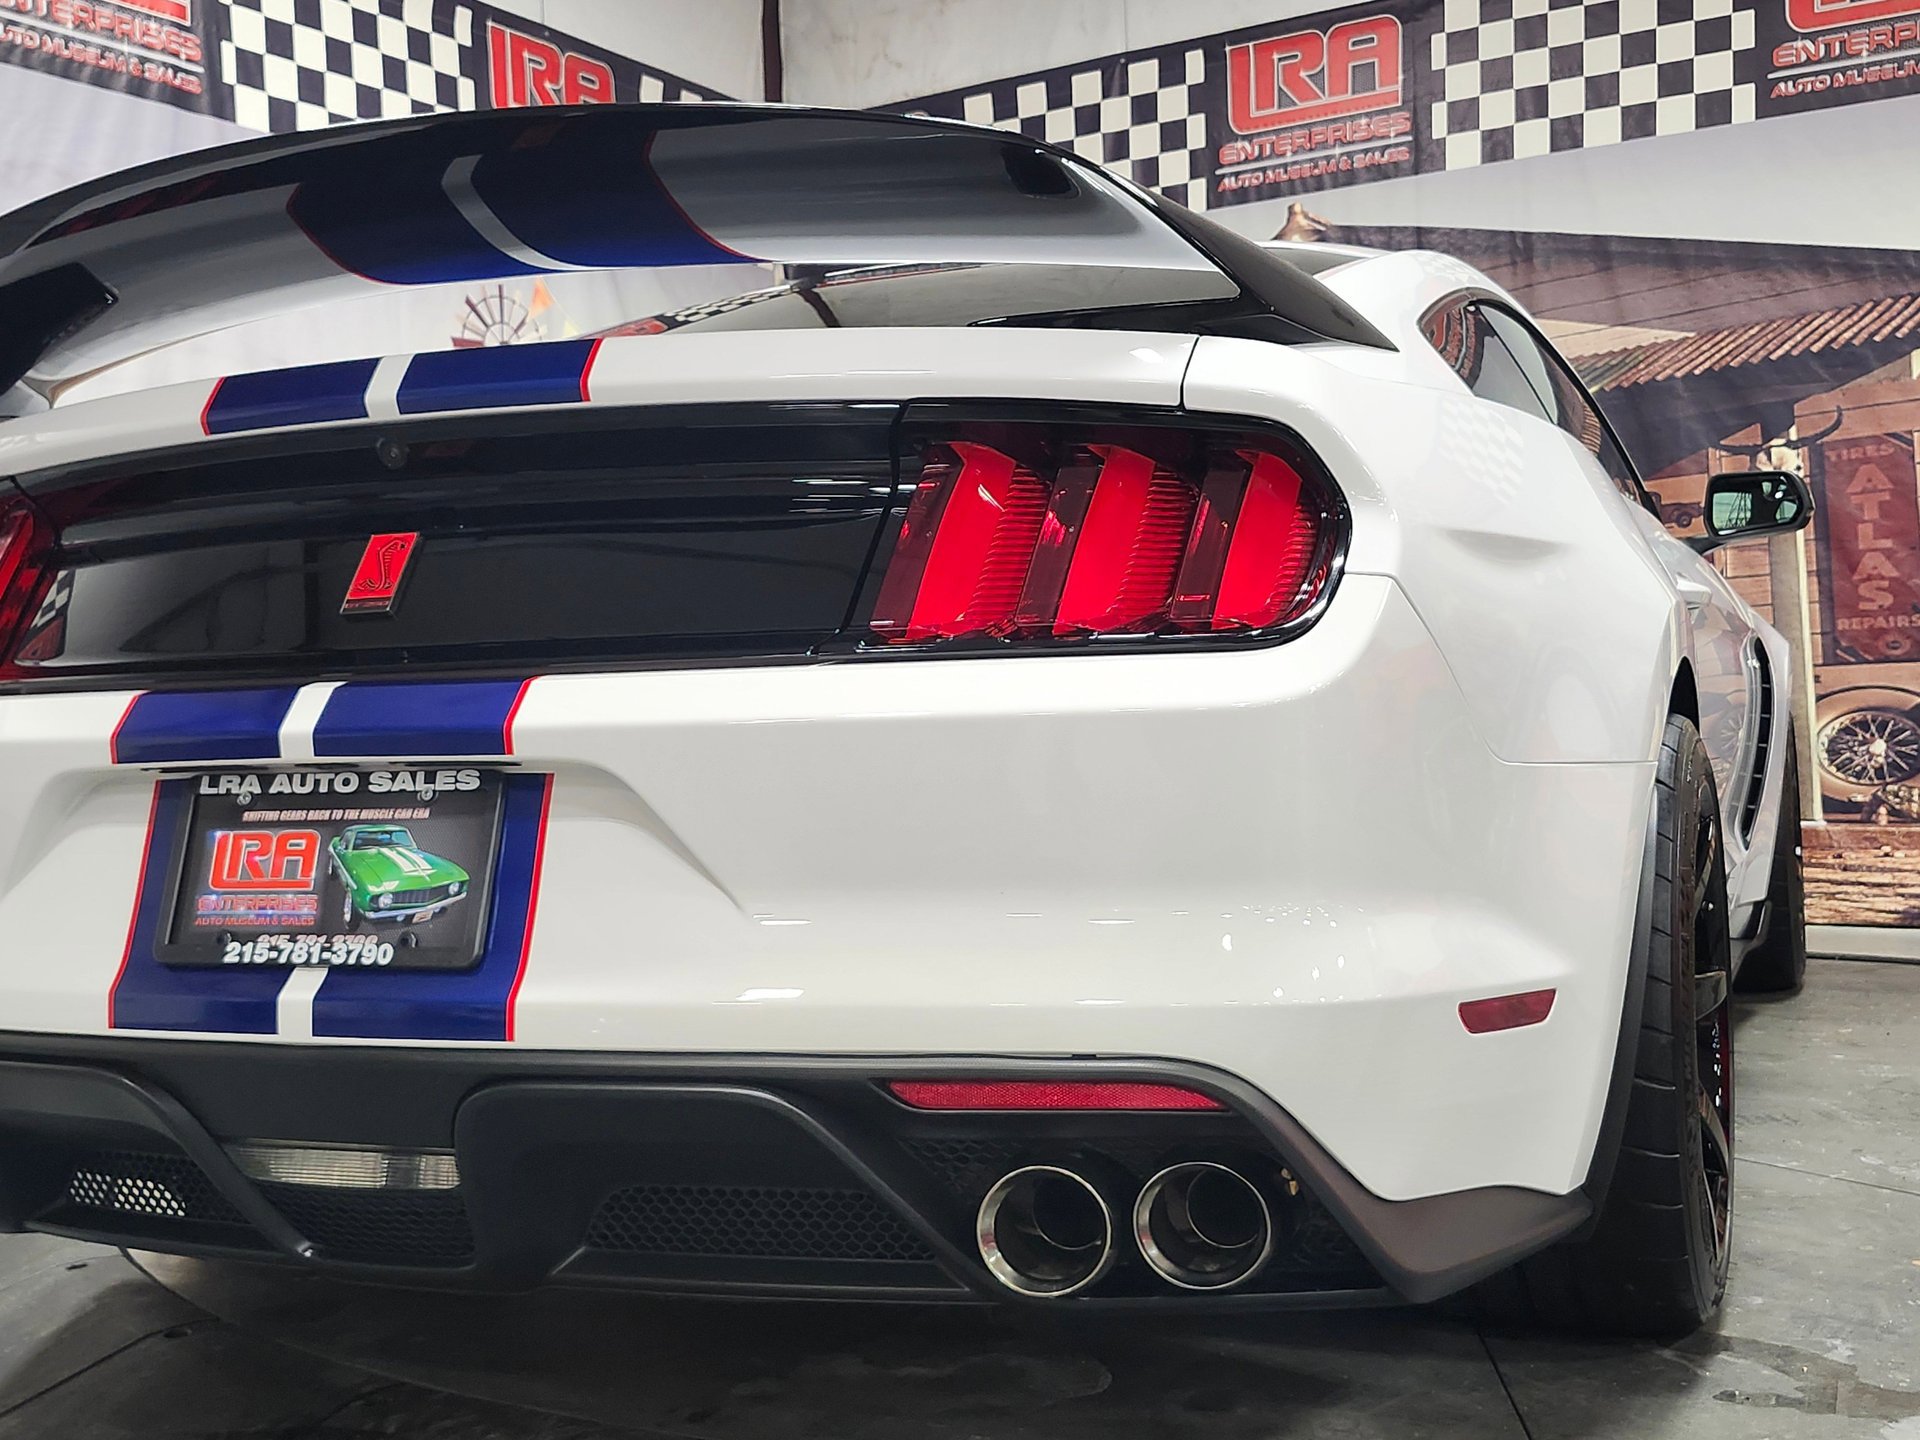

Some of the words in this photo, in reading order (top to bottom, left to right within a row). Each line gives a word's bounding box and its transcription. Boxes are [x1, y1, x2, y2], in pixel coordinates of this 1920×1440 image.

[1772, 19, 1920, 67] ENTERP
[41, 33, 127, 73] MUSEUM
[129, 57, 144, 79] &
[144, 62, 202, 95] SALES
[1226, 14, 1403, 135] LRA
[1770, 74, 1831, 98] AUTO
[1218, 111, 1411, 165] ENTERPRISES
[1218, 171, 1264, 192] AUTO
[1265, 159, 1337, 184] MUSEUM
[1339, 157, 1351, 171] &
[1354, 147, 1410, 169] SALES
[1824, 443, 1896, 461] TIRES
[1846, 463, 1900, 610] ATLAS
[1837, 614, 1920, 630] REPAIRS
[200, 774, 261, 794] LRA
[268, 772, 359, 794] AUTO
[368, 769, 481, 793] SALES
[331, 809, 344, 820] TO
[344, 809, 361, 820] THE
[360, 808, 395, 820] MUSCLE
[209, 829, 321, 891] LRA
[198, 894, 318, 911] ENTERPRISES
[195, 917, 224, 926] AUTO
[225, 917, 269, 926] MUSEUM
[281, 917, 315, 926] SALES
[223, 941, 394, 966] 215-781-3790
